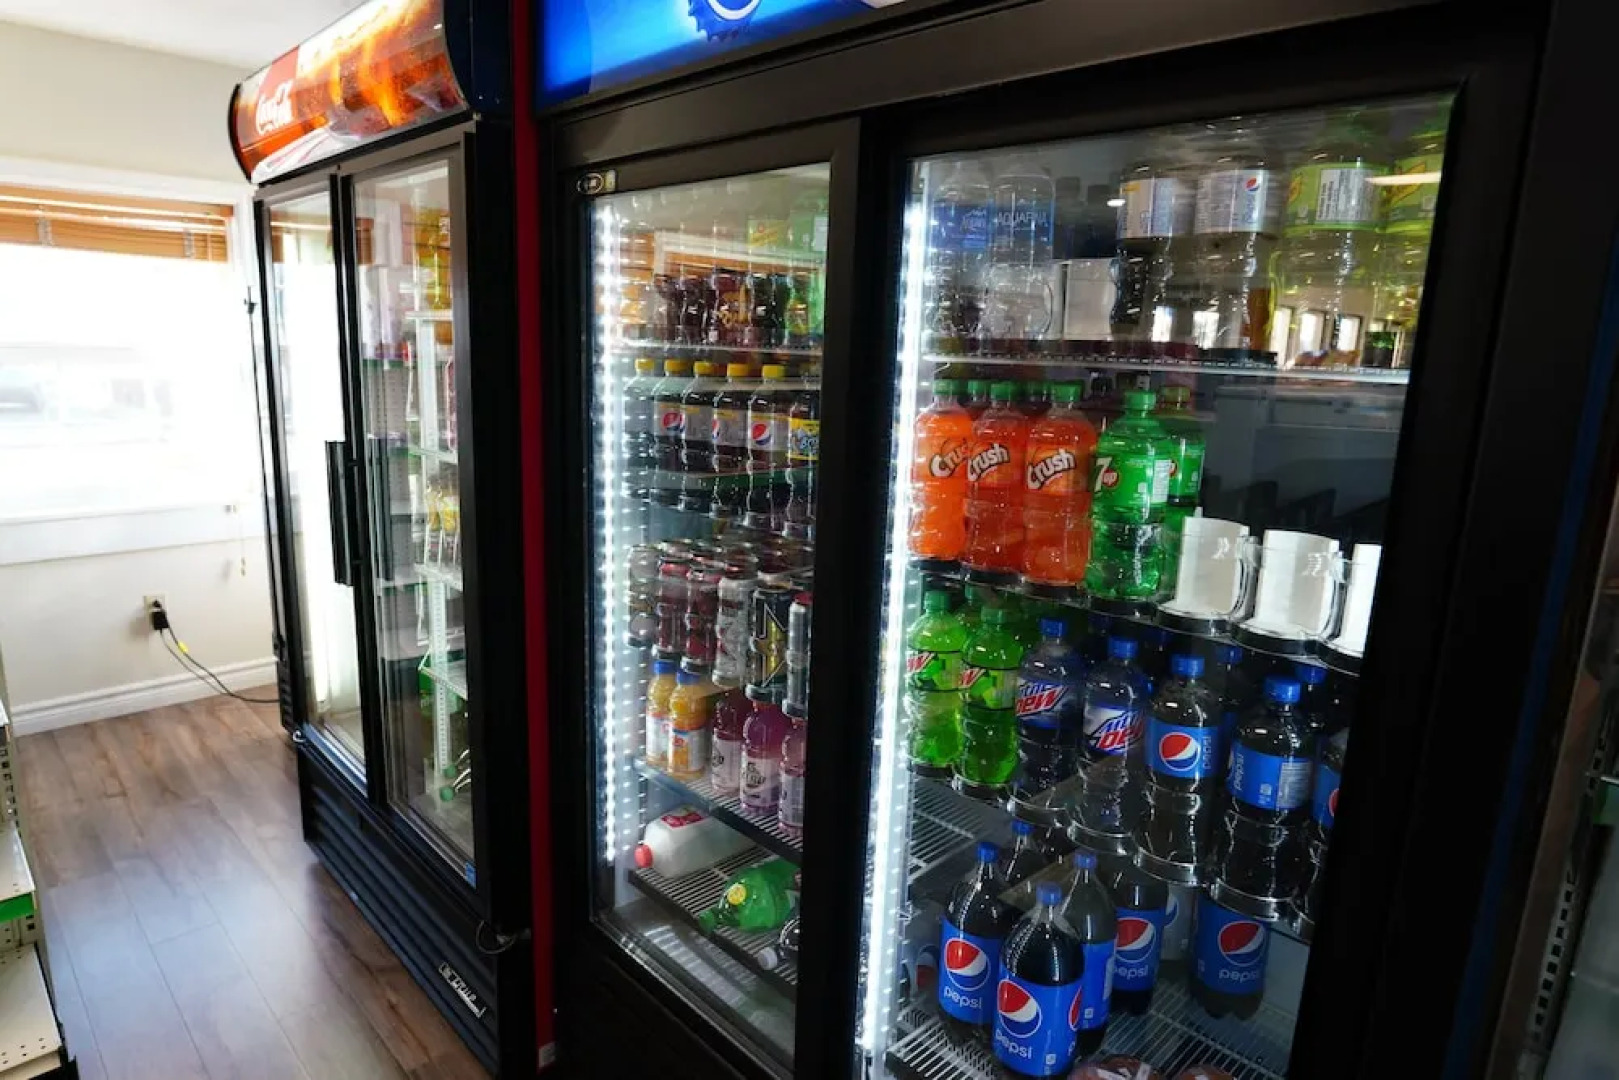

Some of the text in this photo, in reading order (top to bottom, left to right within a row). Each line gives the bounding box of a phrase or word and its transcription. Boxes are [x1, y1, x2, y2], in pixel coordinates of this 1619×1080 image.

[1026, 447, 1077, 490] Crush
[943, 986, 982, 1009] pepsi
[995, 1029, 1032, 1060] pepsi
